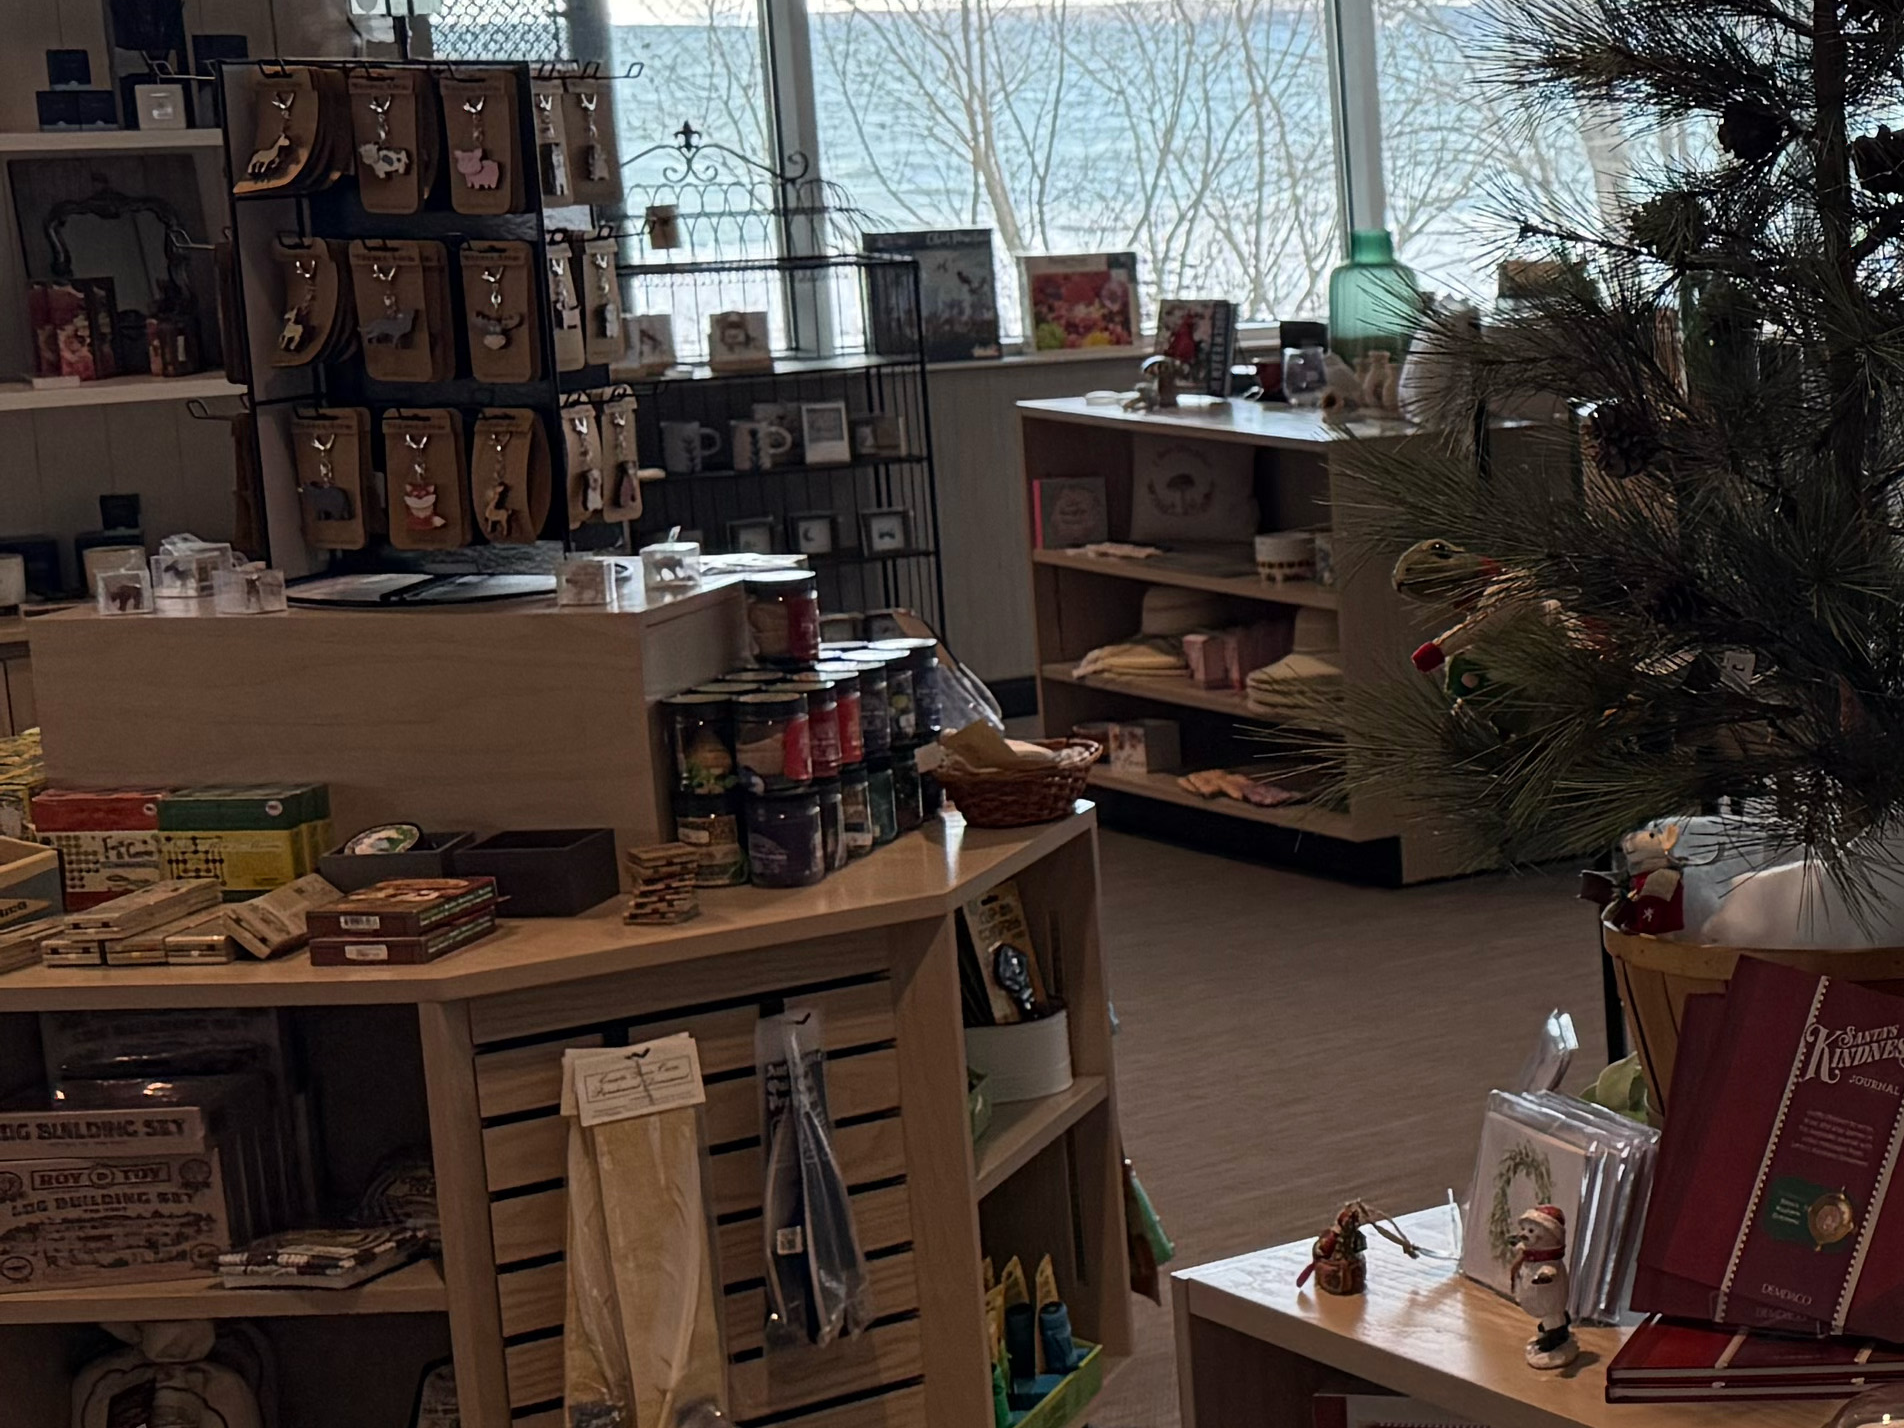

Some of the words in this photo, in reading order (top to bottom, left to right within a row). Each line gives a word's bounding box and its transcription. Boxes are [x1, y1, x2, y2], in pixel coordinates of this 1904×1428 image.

[1838, 1024, 1900, 1048] SANTA'S
[1849, 1074, 1900, 1096] JOURNAL
[36, 1120, 138, 1140] BUILDING
[143, 1118, 185, 1137] SET
[40, 1173, 82, 1186] ROY
[122, 1167, 162, 1181] TOY
[12, 1199, 48, 1217] LOG
[55, 1192, 151, 1209] BUILDING
[157, 1192, 194, 1205] SET
